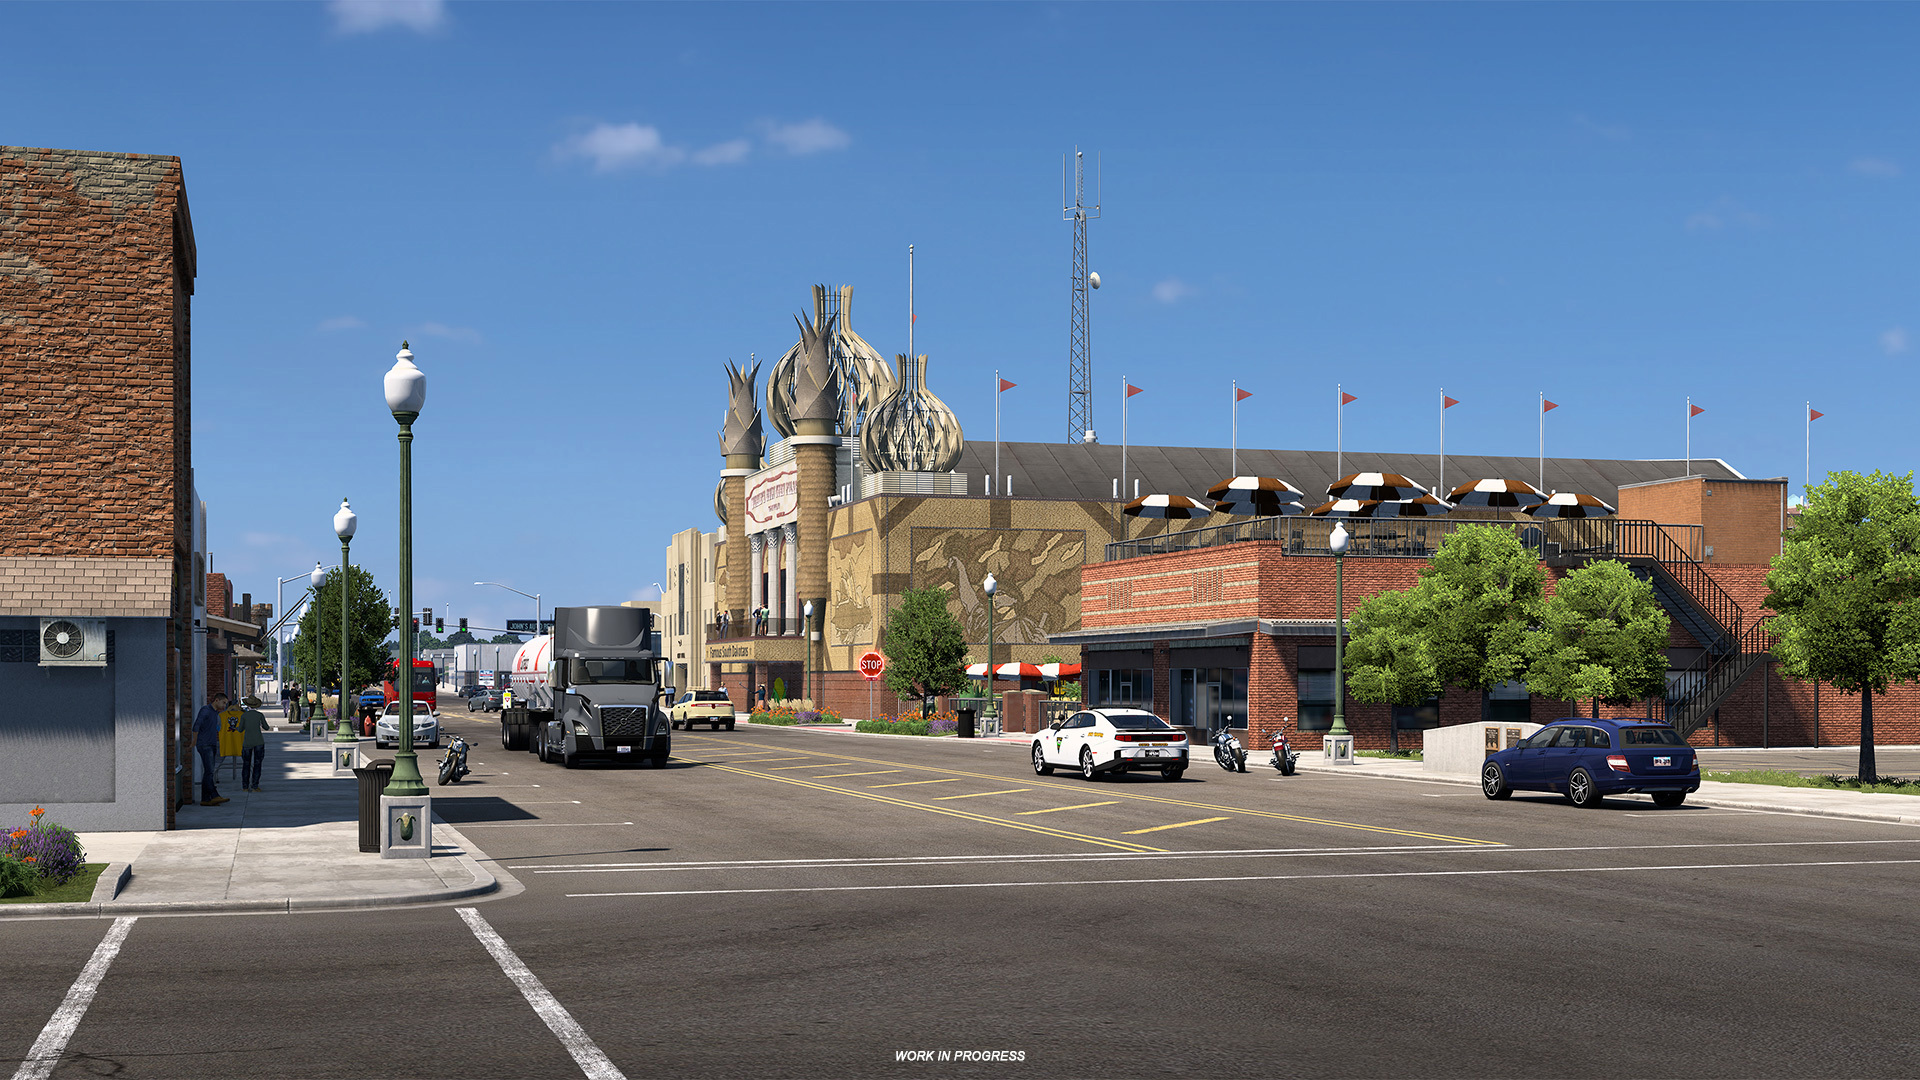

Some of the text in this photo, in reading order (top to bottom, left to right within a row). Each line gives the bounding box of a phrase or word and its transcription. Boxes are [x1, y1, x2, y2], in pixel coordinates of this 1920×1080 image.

[710, 646, 722, 658] Famous
[722, 645, 732, 657] South
[862, 660, 881, 669] STOP
